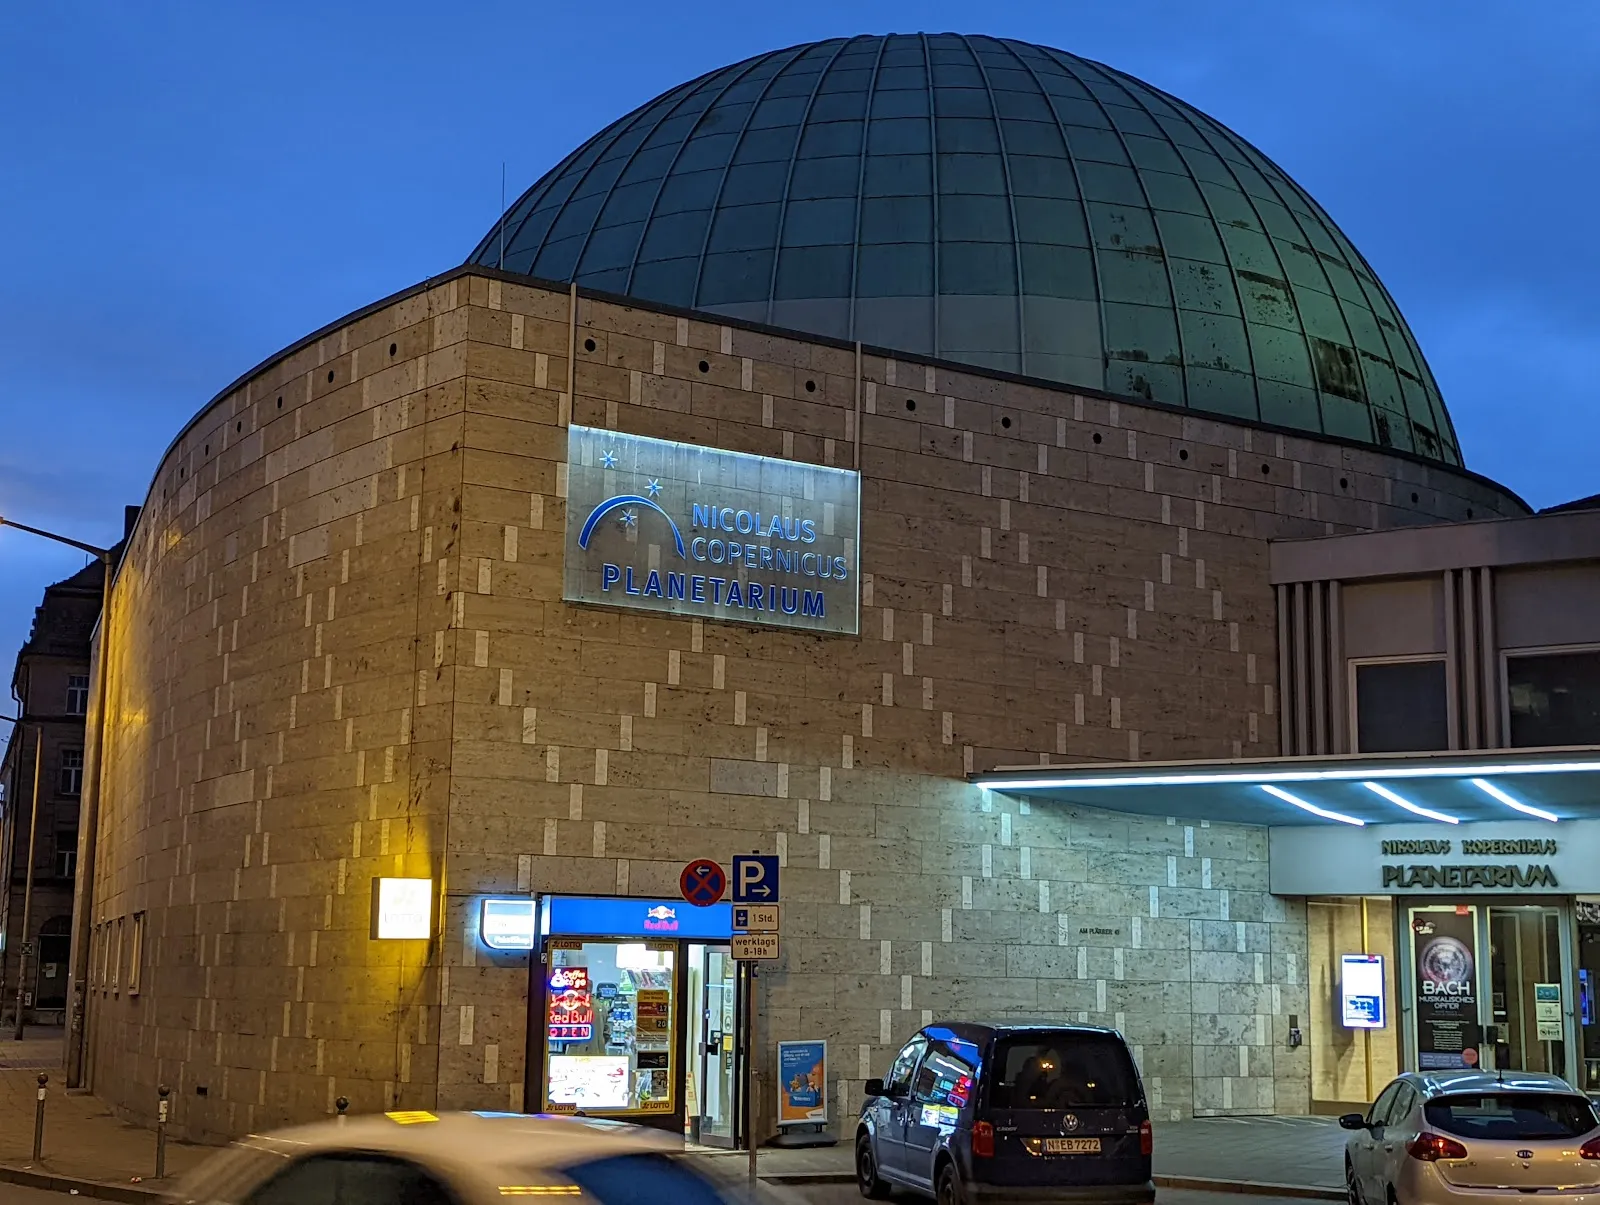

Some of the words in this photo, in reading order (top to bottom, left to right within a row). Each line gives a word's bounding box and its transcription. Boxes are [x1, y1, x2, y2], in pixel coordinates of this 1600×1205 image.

[692, 503, 816, 544] NICOLAUS
[691, 537, 848, 581] COPERNICUS
[601, 563, 825, 618] PLANETARIUM
[739, 860, 765, 897] P
[758, 914, 775, 923] Std.
[560, 940, 581, 949] LOTTO
[654, 942, 674, 950] LOTTO
[735, 938, 776, 948] werktags
[562, 969, 586, 981] Coffee
[574, 979, 587, 989] go
[1422, 980, 1471, 996] BACH
[1418, 995, 1475, 1004] MUSIKALISCHES
[1434, 1002, 1460, 1010] OPFER
[549, 1010, 569, 1024] Red
[570, 1010, 593, 1024] Bull
[549, 1027, 588, 1038] OPEN
[554, 1104, 576, 1112] LOTTO
[650, 1102, 670, 1110] LOTTO
[1047, 1139, 1056, 1150] N
[1060, 1139, 1075, 1150] EB
[1075, 1139, 1100, 1150] 7272
